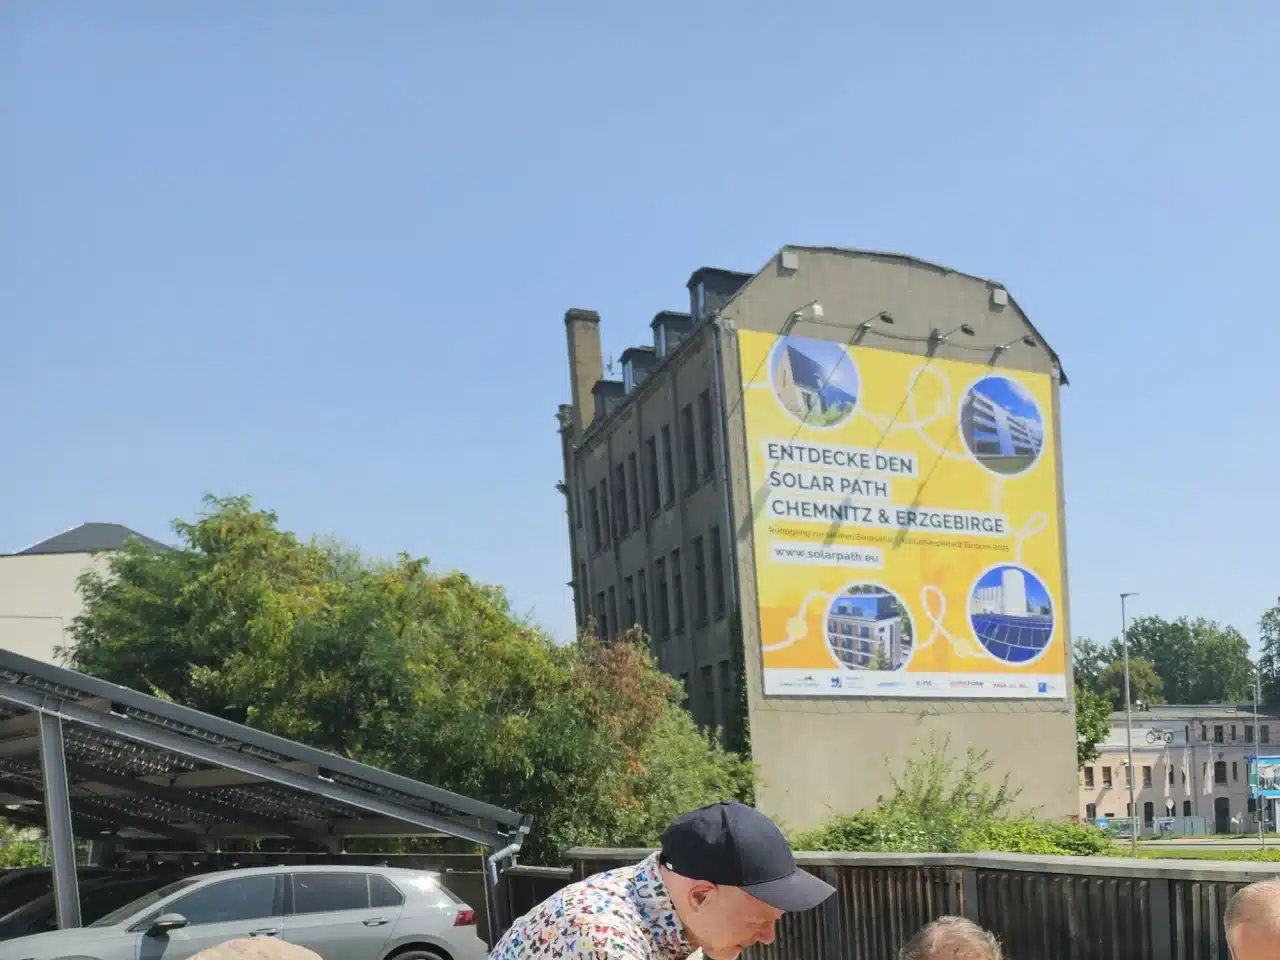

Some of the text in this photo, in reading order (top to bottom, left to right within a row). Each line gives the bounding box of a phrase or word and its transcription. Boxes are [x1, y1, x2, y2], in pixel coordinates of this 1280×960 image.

[767, 443, 913, 474] ENTDECKE DEN
[769, 471, 888, 497] SOLAR PATH
[771, 499, 1004, 533] CHEMNITZ & ERZGEBIRGE
[775, 547, 879, 563] www.solarpath.eu
